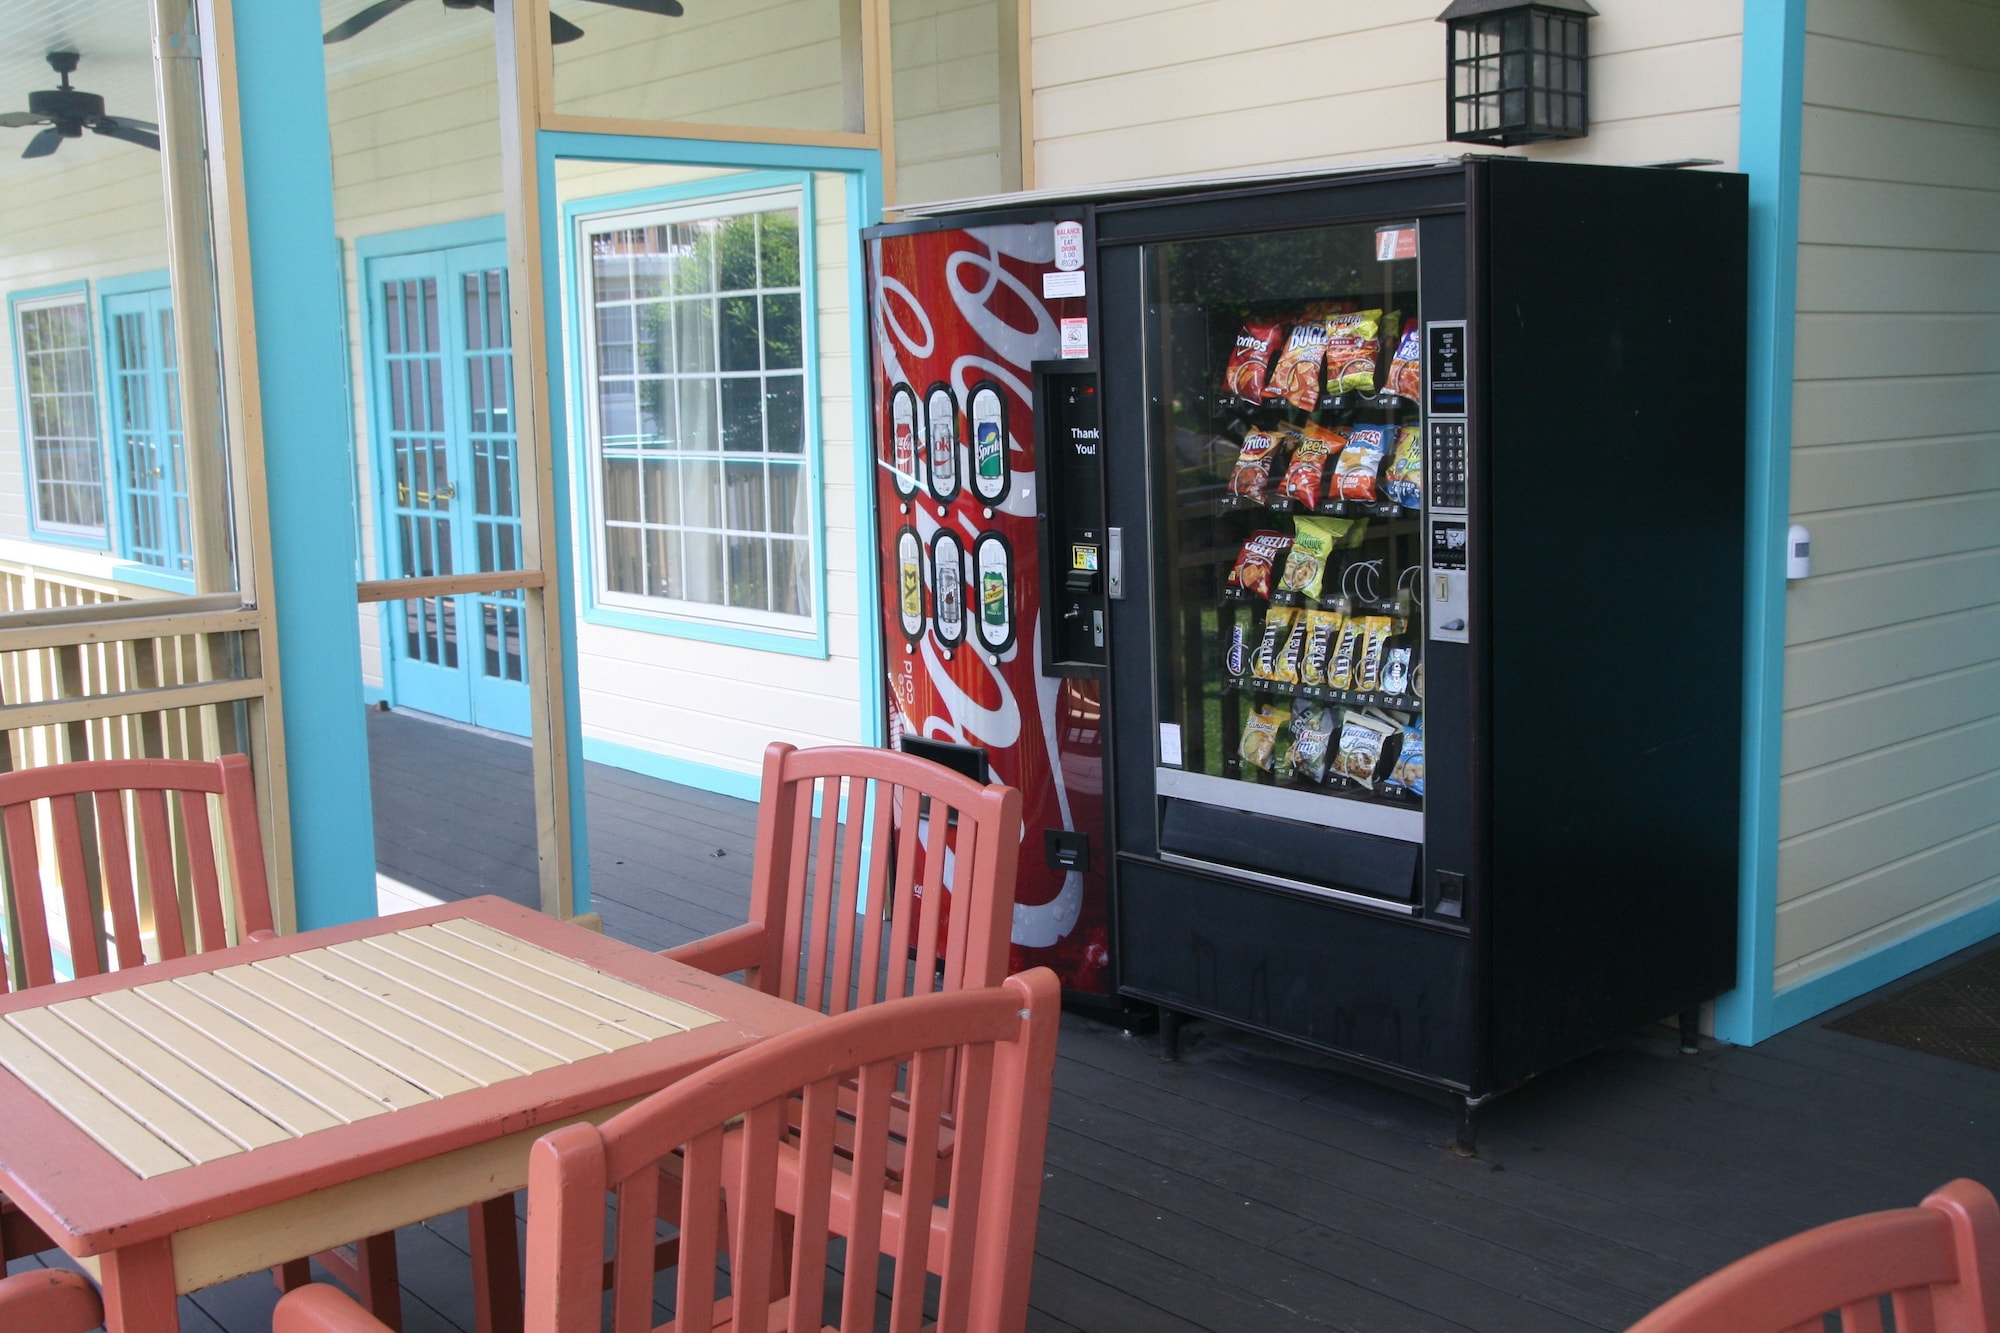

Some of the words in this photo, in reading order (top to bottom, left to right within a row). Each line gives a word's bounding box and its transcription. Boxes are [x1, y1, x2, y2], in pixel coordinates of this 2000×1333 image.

[1057, 228, 1080, 236] BALANCE
[1289, 326, 1328, 352] BUGL
[1071, 427, 1100, 439] Thank
[1075, 443, 1096, 455] You!
[1243, 434, 1271, 450] Fritos
[978, 440, 1001, 461] Sprite
[1392, 651, 1401, 689] eclipe
[903, 660, 914, 704] cold
[1291, 710, 1314, 733] BOLD
[1341, 726, 1382, 741] Famous
[1343, 739, 1378, 752] Amos
